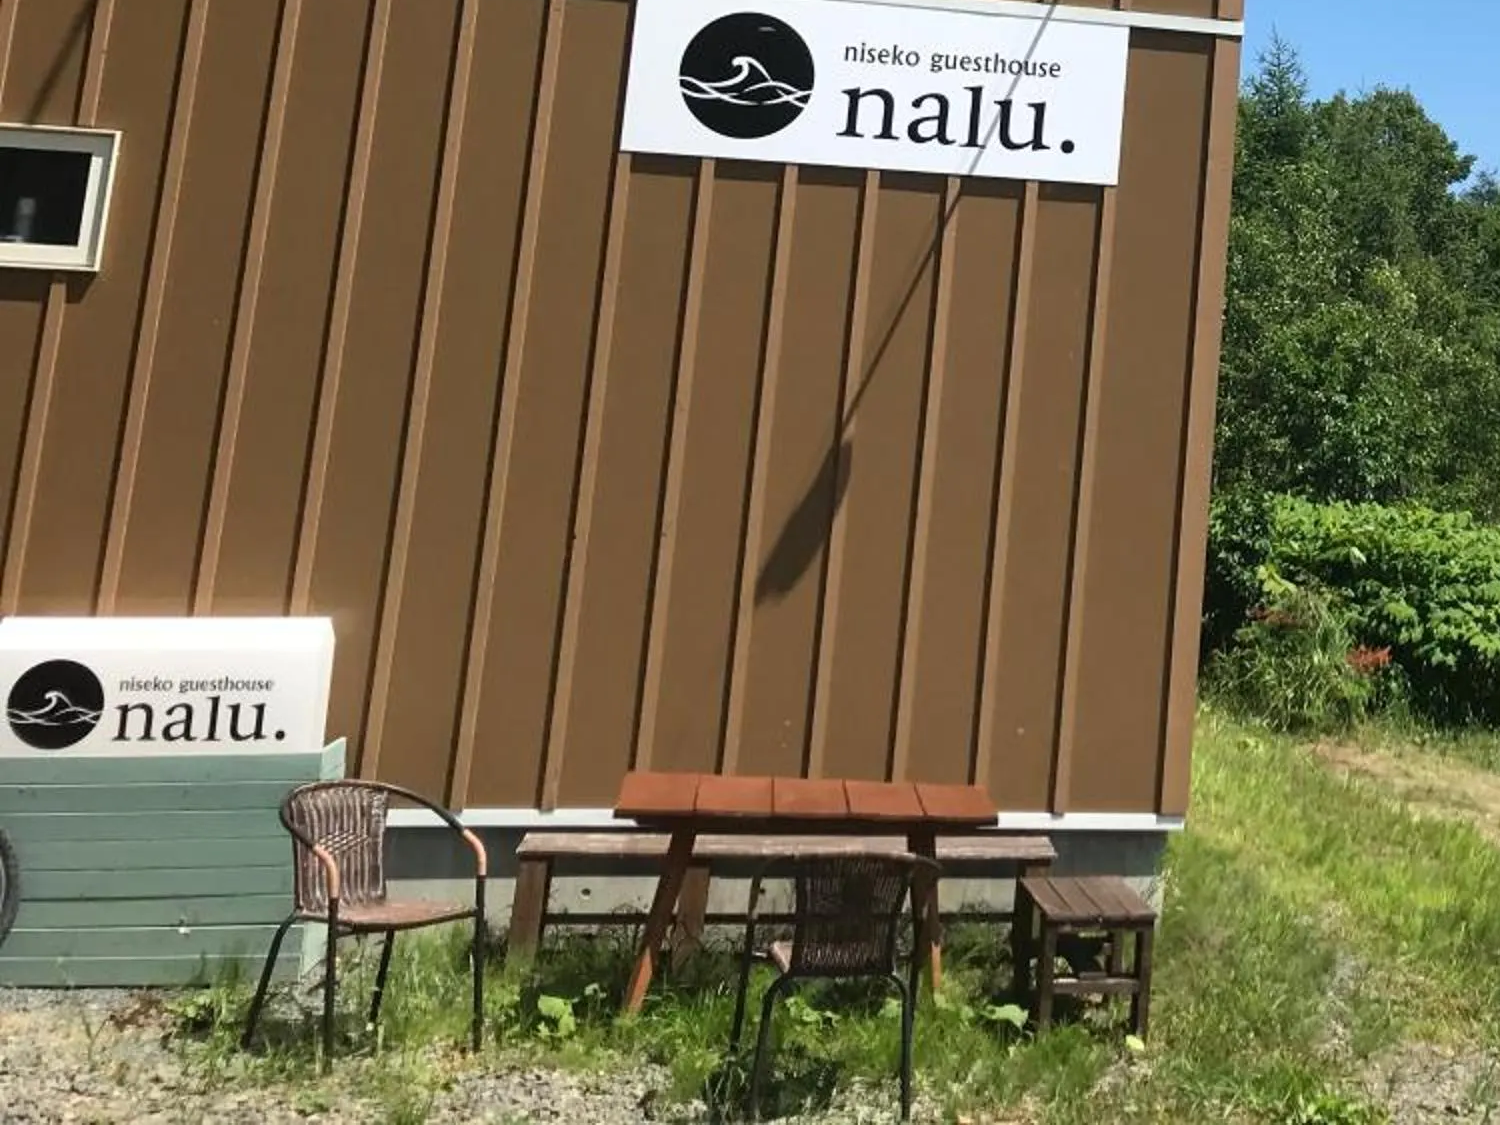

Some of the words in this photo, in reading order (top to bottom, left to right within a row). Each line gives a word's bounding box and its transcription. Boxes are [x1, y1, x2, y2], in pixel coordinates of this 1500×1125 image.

[843, 42, 921, 68] niseko
[929, 52, 1062, 79] guesthouse
[835, 83, 1076, 155] nalu.
[119, 675, 173, 692] niseko
[179, 676, 275, 694] guesthouse
[111, 695, 286, 742] nalu.
